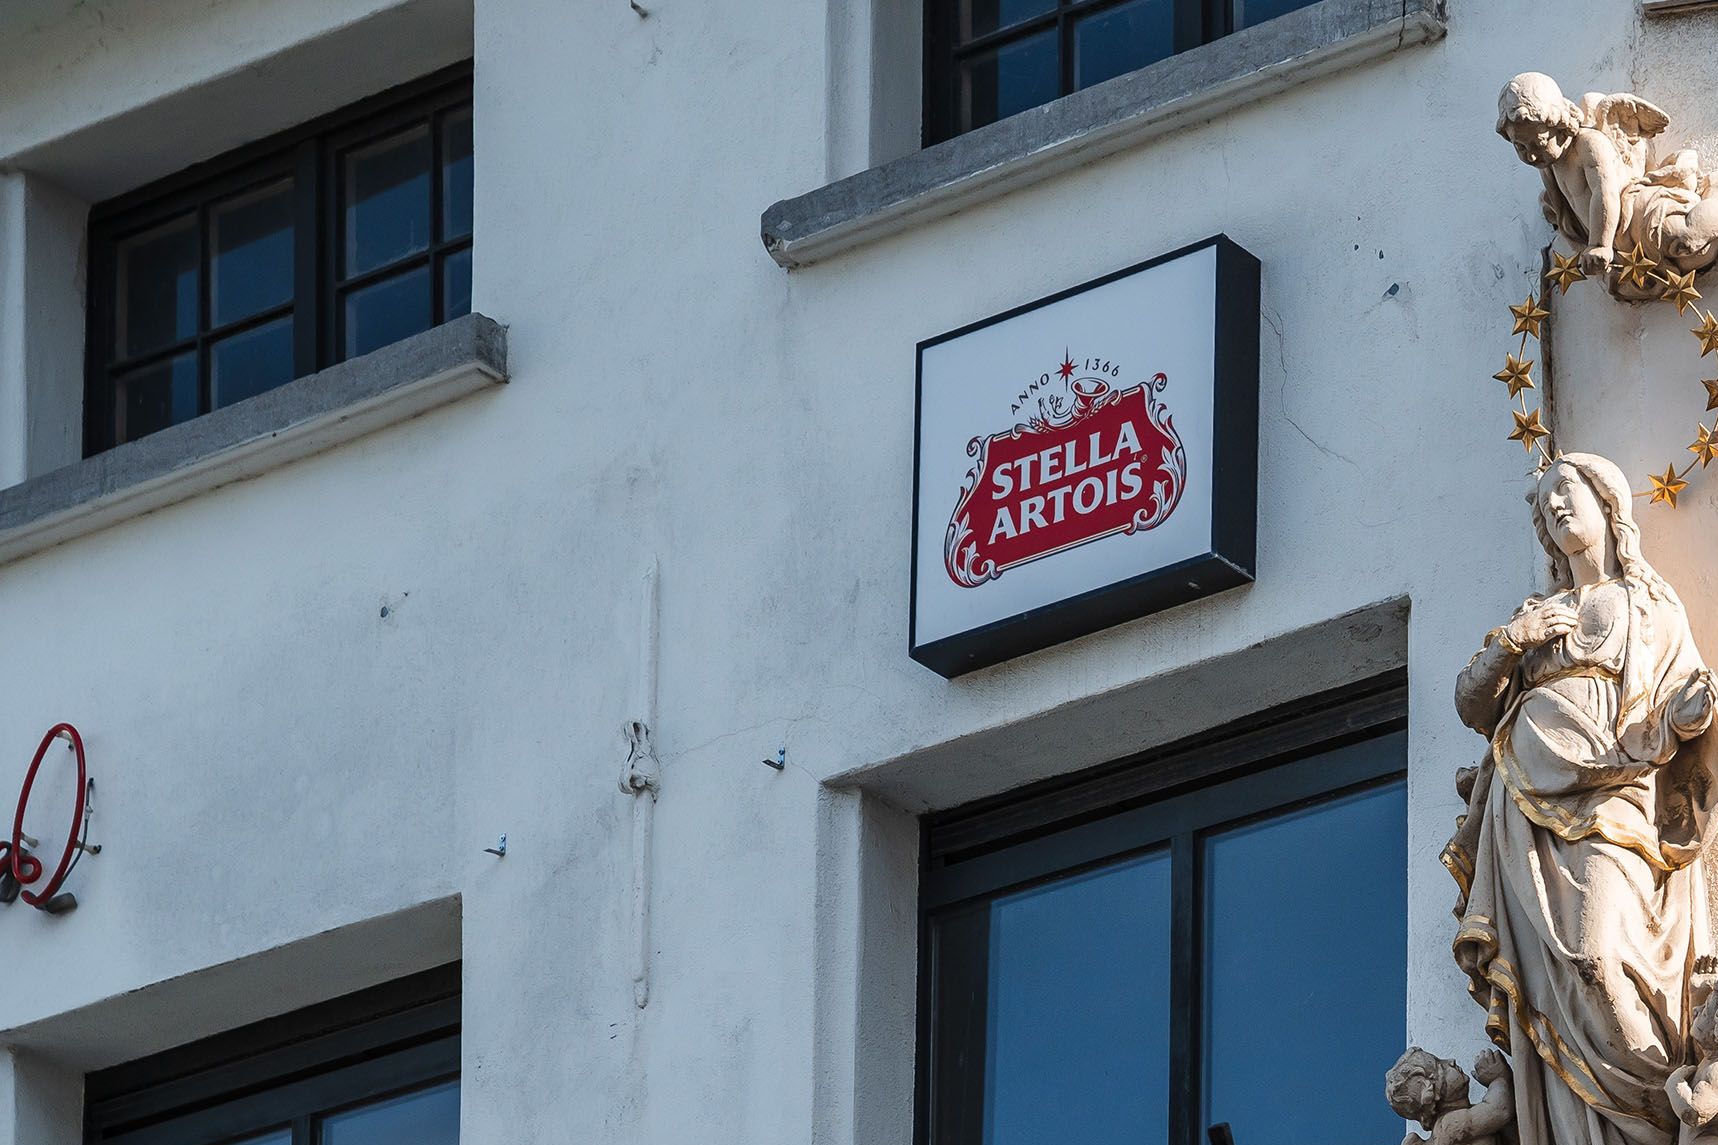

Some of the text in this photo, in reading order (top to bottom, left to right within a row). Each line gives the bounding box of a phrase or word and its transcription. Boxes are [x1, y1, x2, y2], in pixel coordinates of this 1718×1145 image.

[1010, 358, 1120, 416] ANNO 1366
[991, 420, 1143, 500] STELLA
[987, 461, 1143, 545] ARTOIS
